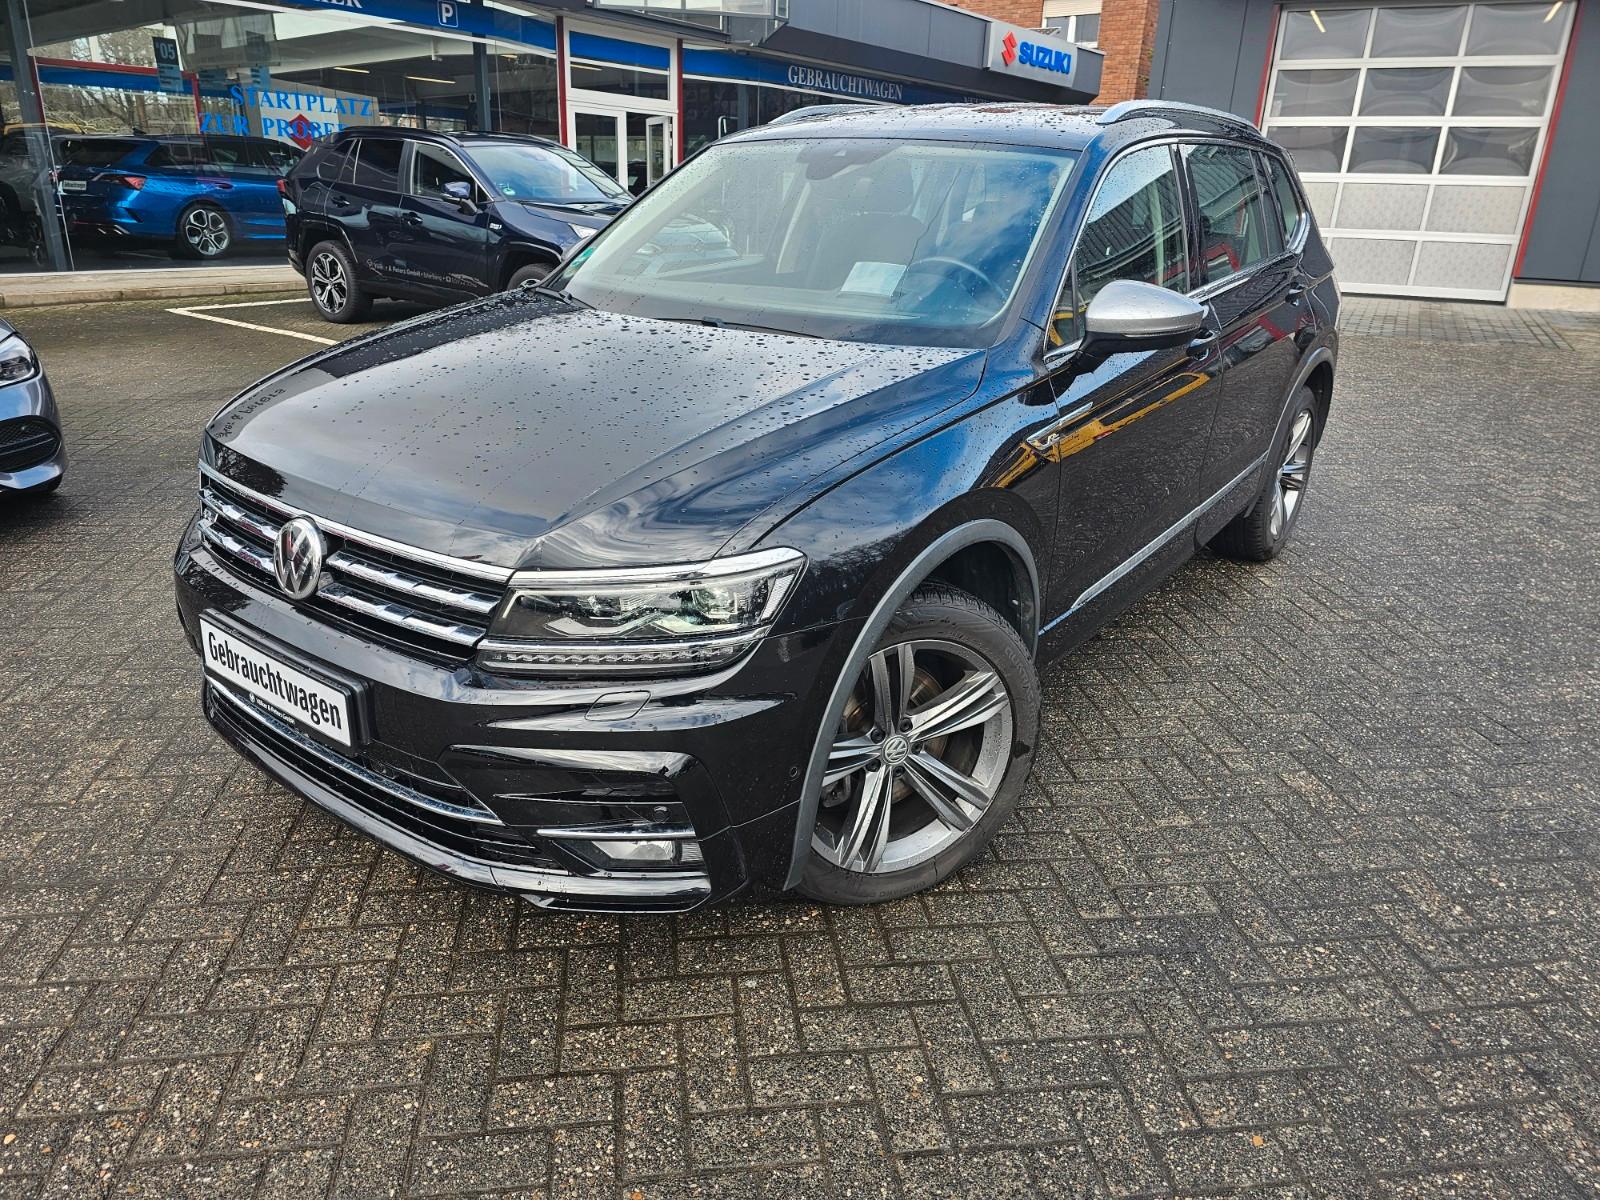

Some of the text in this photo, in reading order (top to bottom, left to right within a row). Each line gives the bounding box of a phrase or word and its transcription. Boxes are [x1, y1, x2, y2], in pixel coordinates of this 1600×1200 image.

[441, 4, 454, 23] P
[1018, 41, 1072, 75] SUZUKI
[787, 65, 903, 100] GEBRAUCHTWAGEN
[229, 84, 373, 117] STARTPLATZ
[200, 112, 347, 140] ZUR PROBE
[208, 631, 342, 730] Gebrauchtwagen
